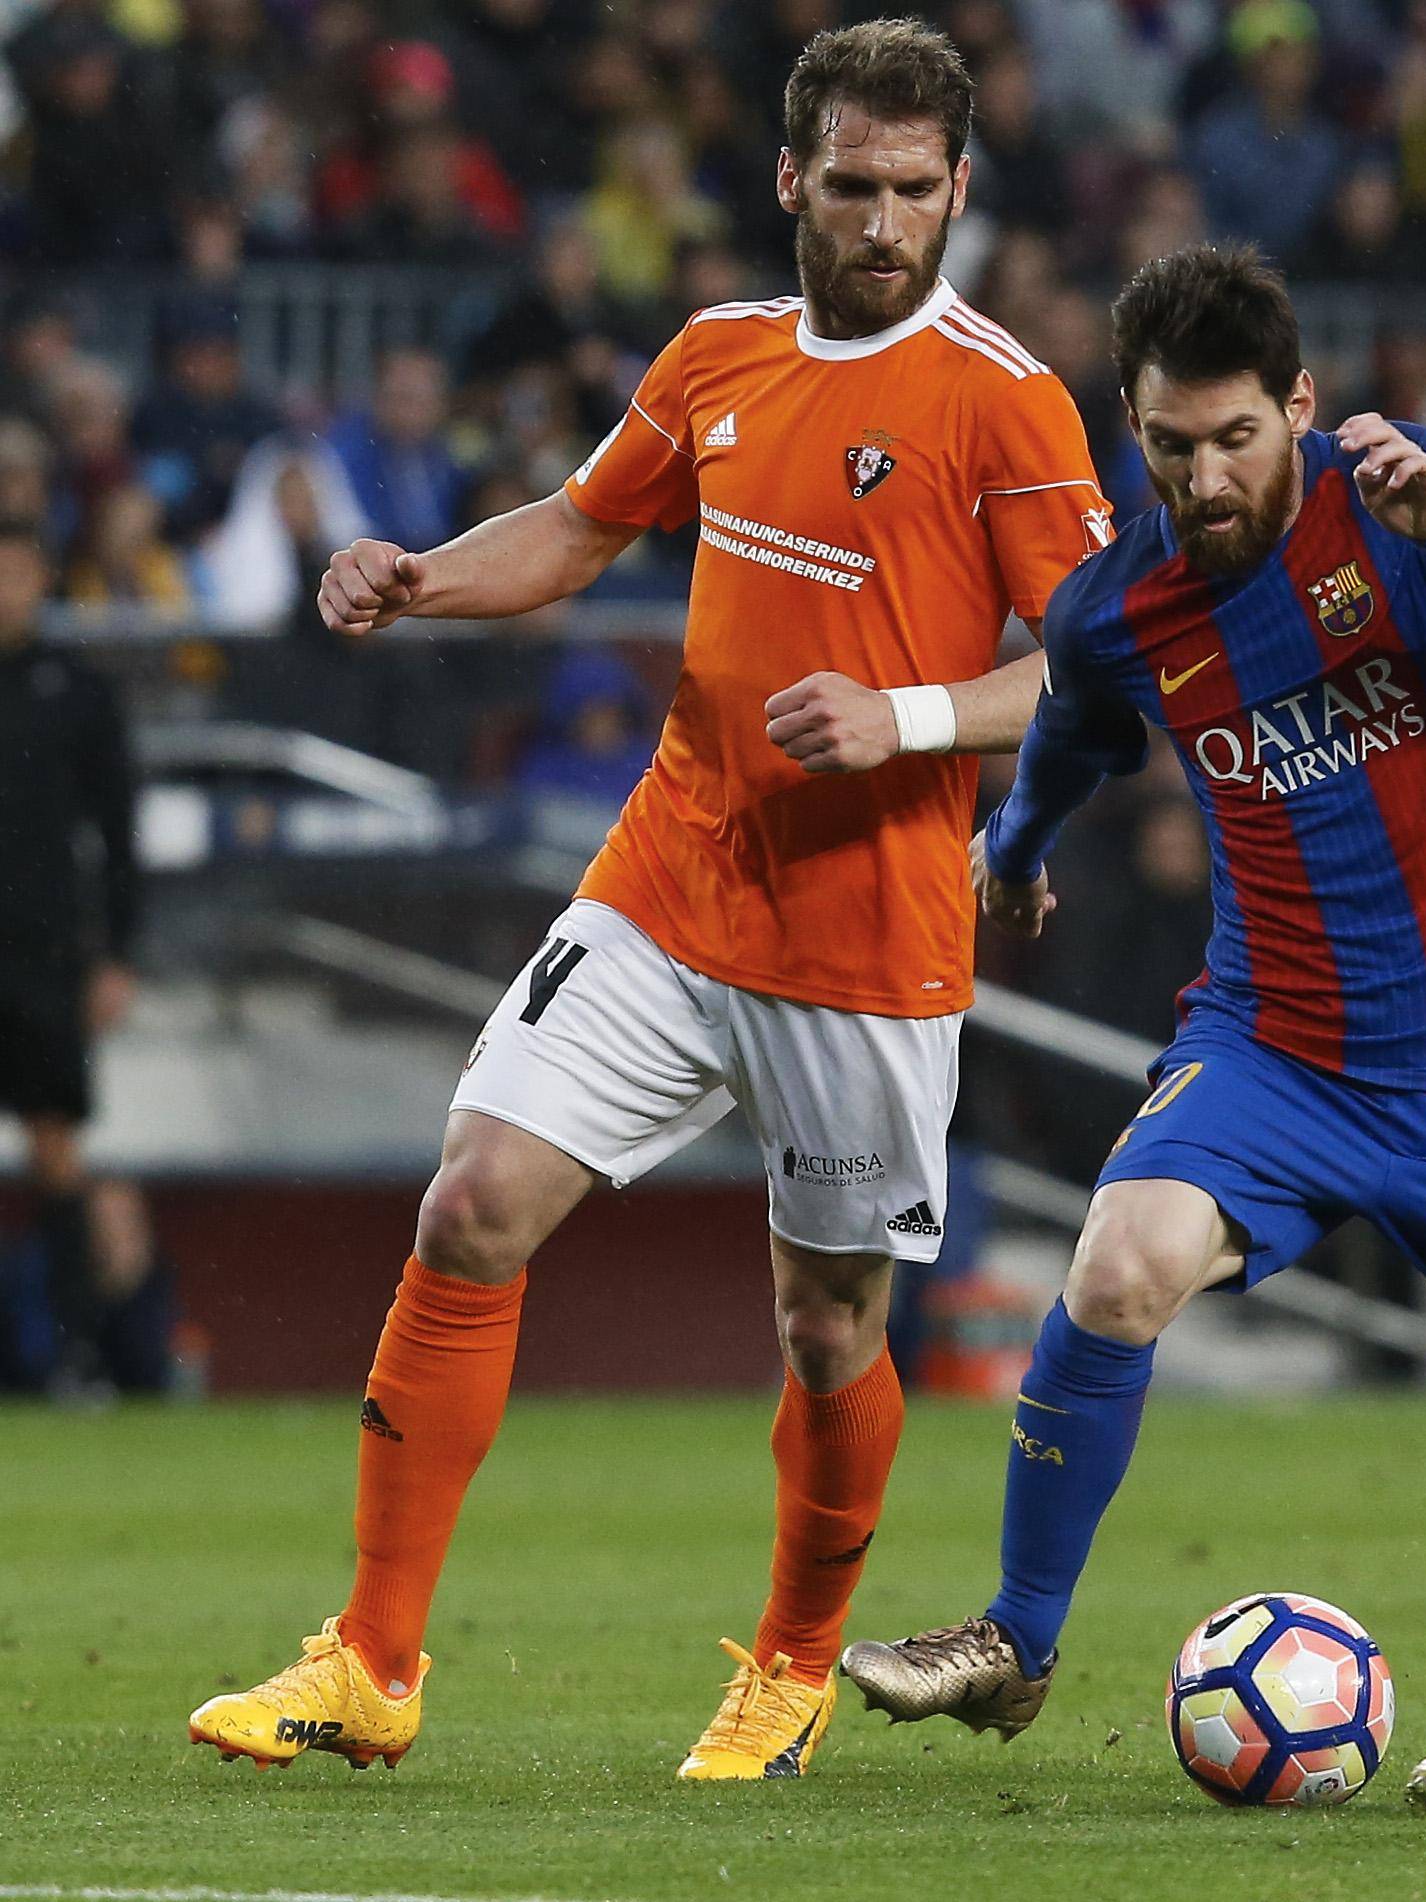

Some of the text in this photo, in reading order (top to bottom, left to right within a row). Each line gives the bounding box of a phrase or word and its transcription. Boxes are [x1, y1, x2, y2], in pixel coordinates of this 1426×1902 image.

[705, 433, 738, 446] adidas
[1195, 657, 1411, 784] QATAR
[1261, 703, 1426, 801] AIRWAYS
[797, 1152, 884, 1176] ACUNSA
[886, 1219, 942, 1237] adidas
